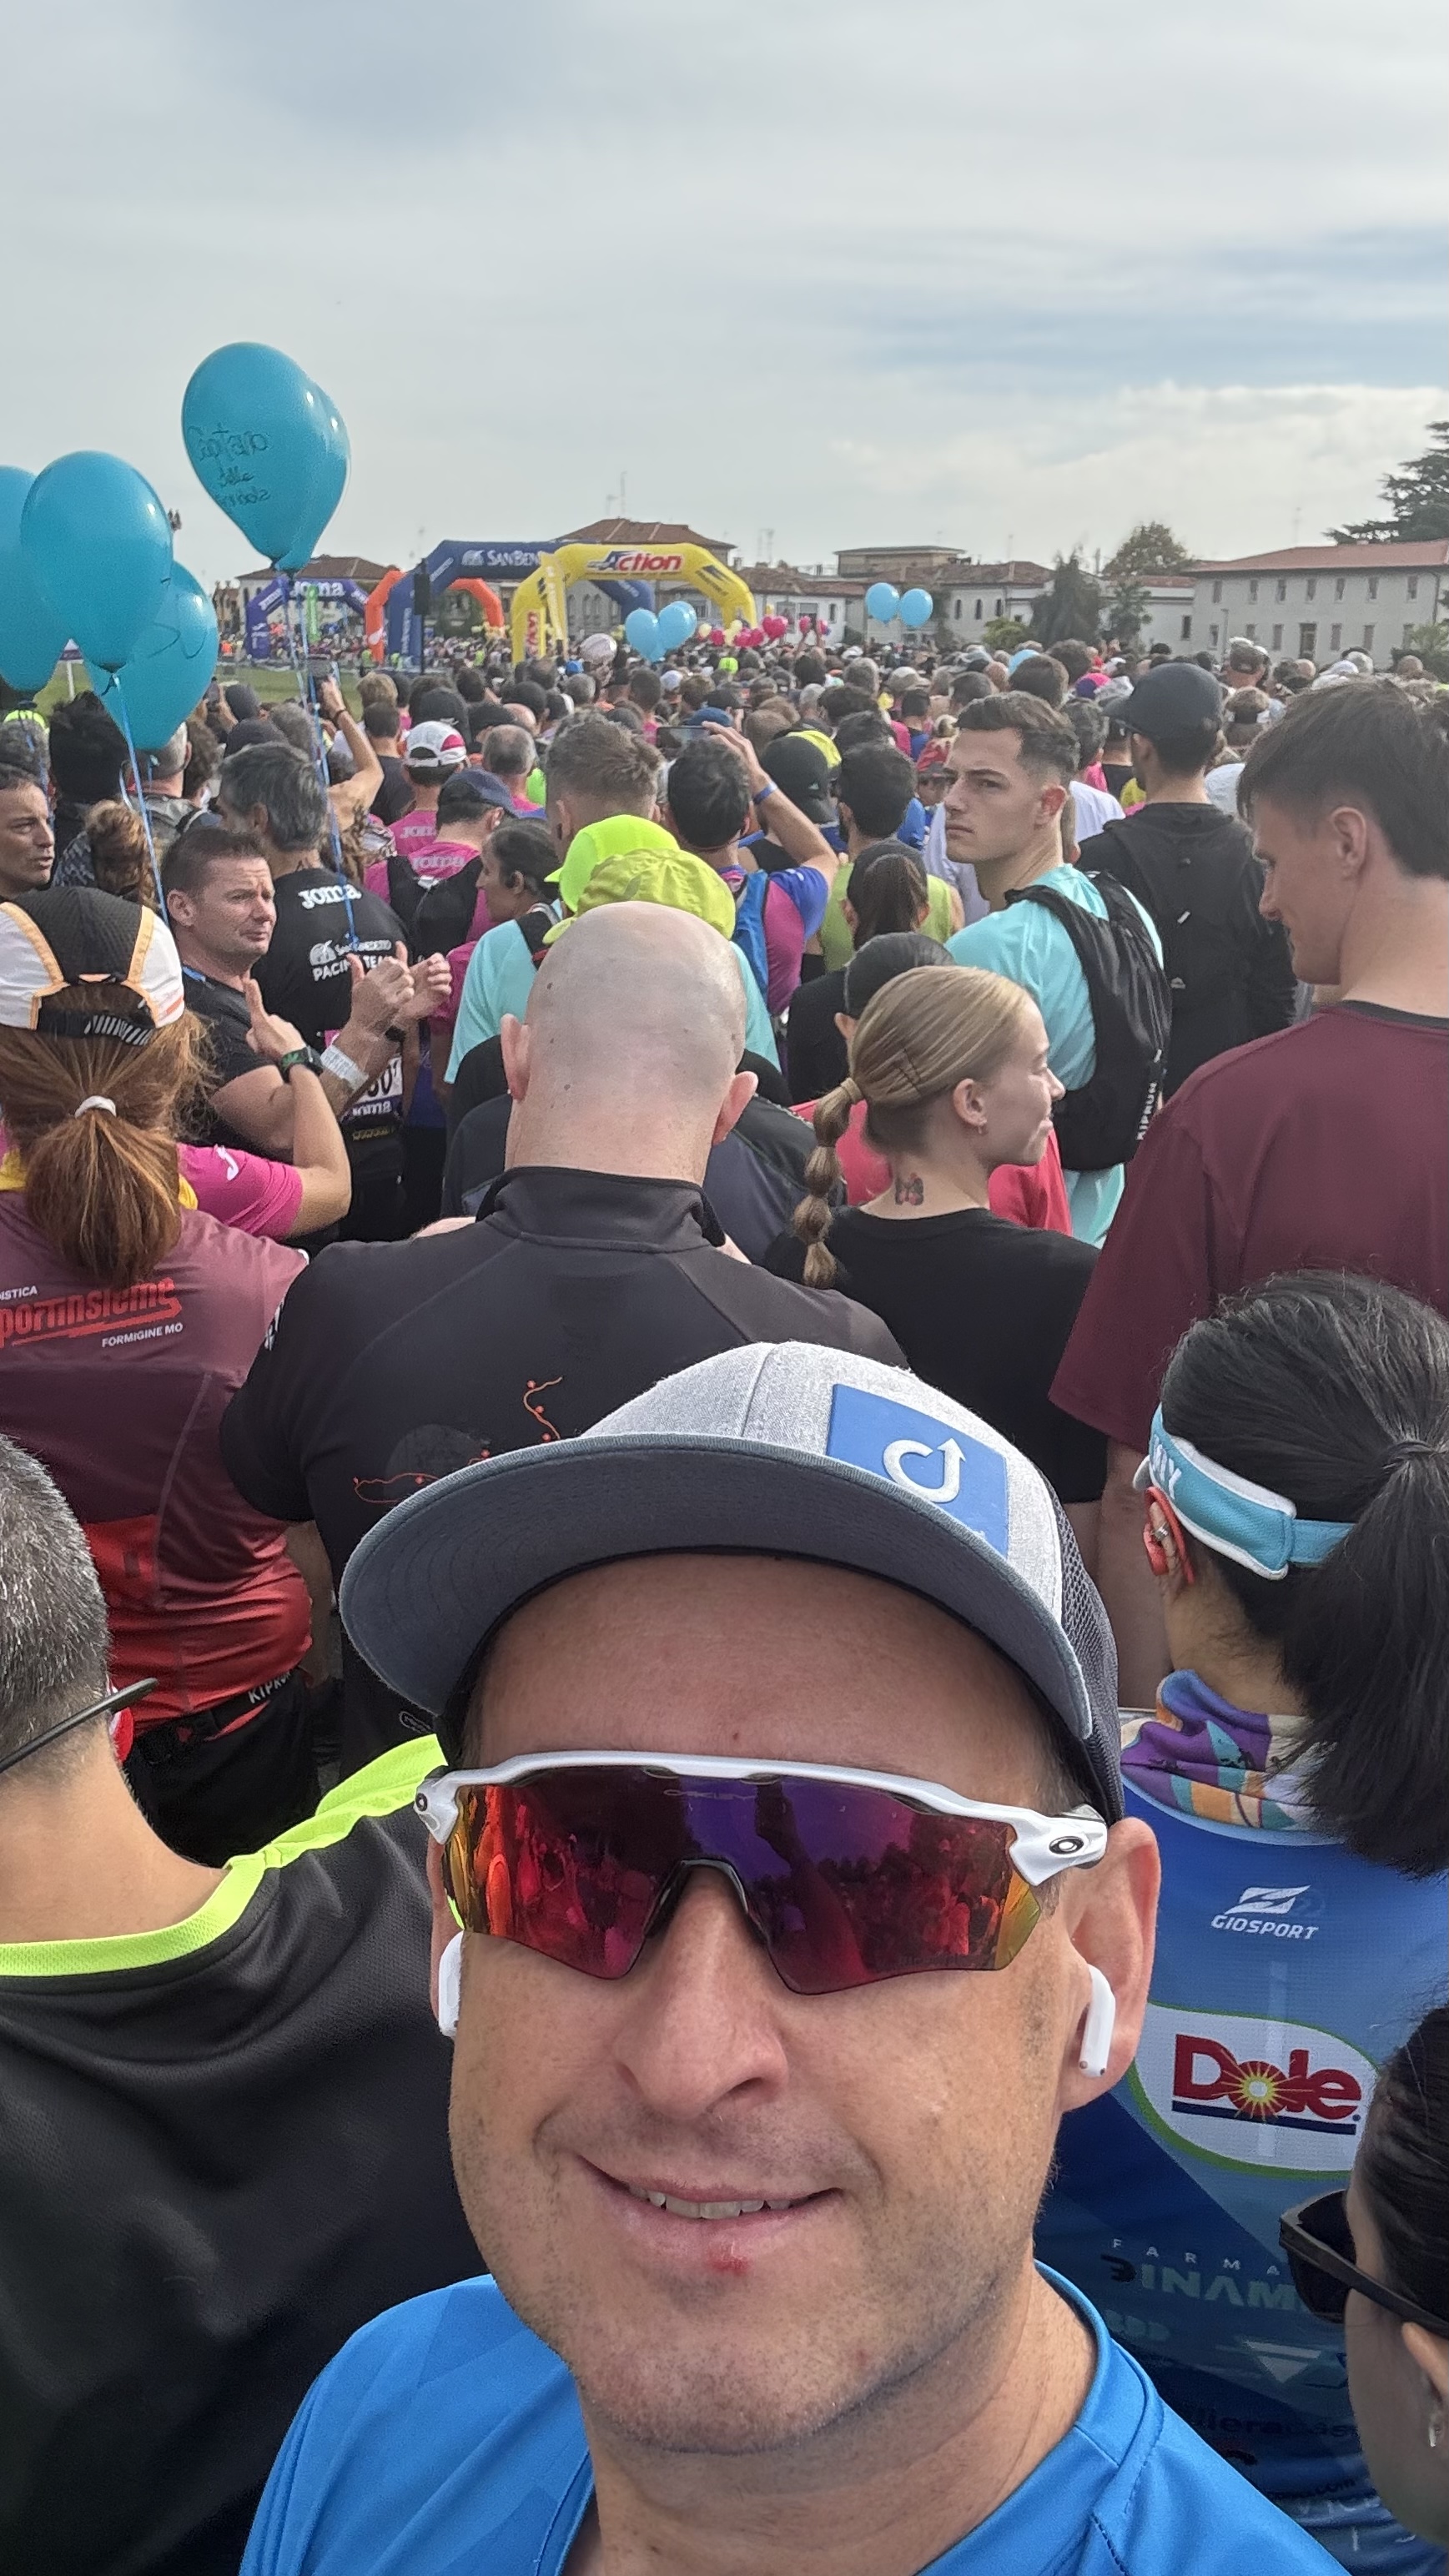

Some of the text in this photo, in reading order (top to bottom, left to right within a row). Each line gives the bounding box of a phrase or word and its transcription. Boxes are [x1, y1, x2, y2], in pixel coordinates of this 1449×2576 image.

[101, 1322, 184, 1348] FORMIGINE MO
[1210, 1914, 1320, 1941] GIOSPORT
[1172, 2033, 1362, 2121] Dole
[1112, 2238, 1281, 2277] FARMA
[1100, 2253, 1303, 2312] DINAM
